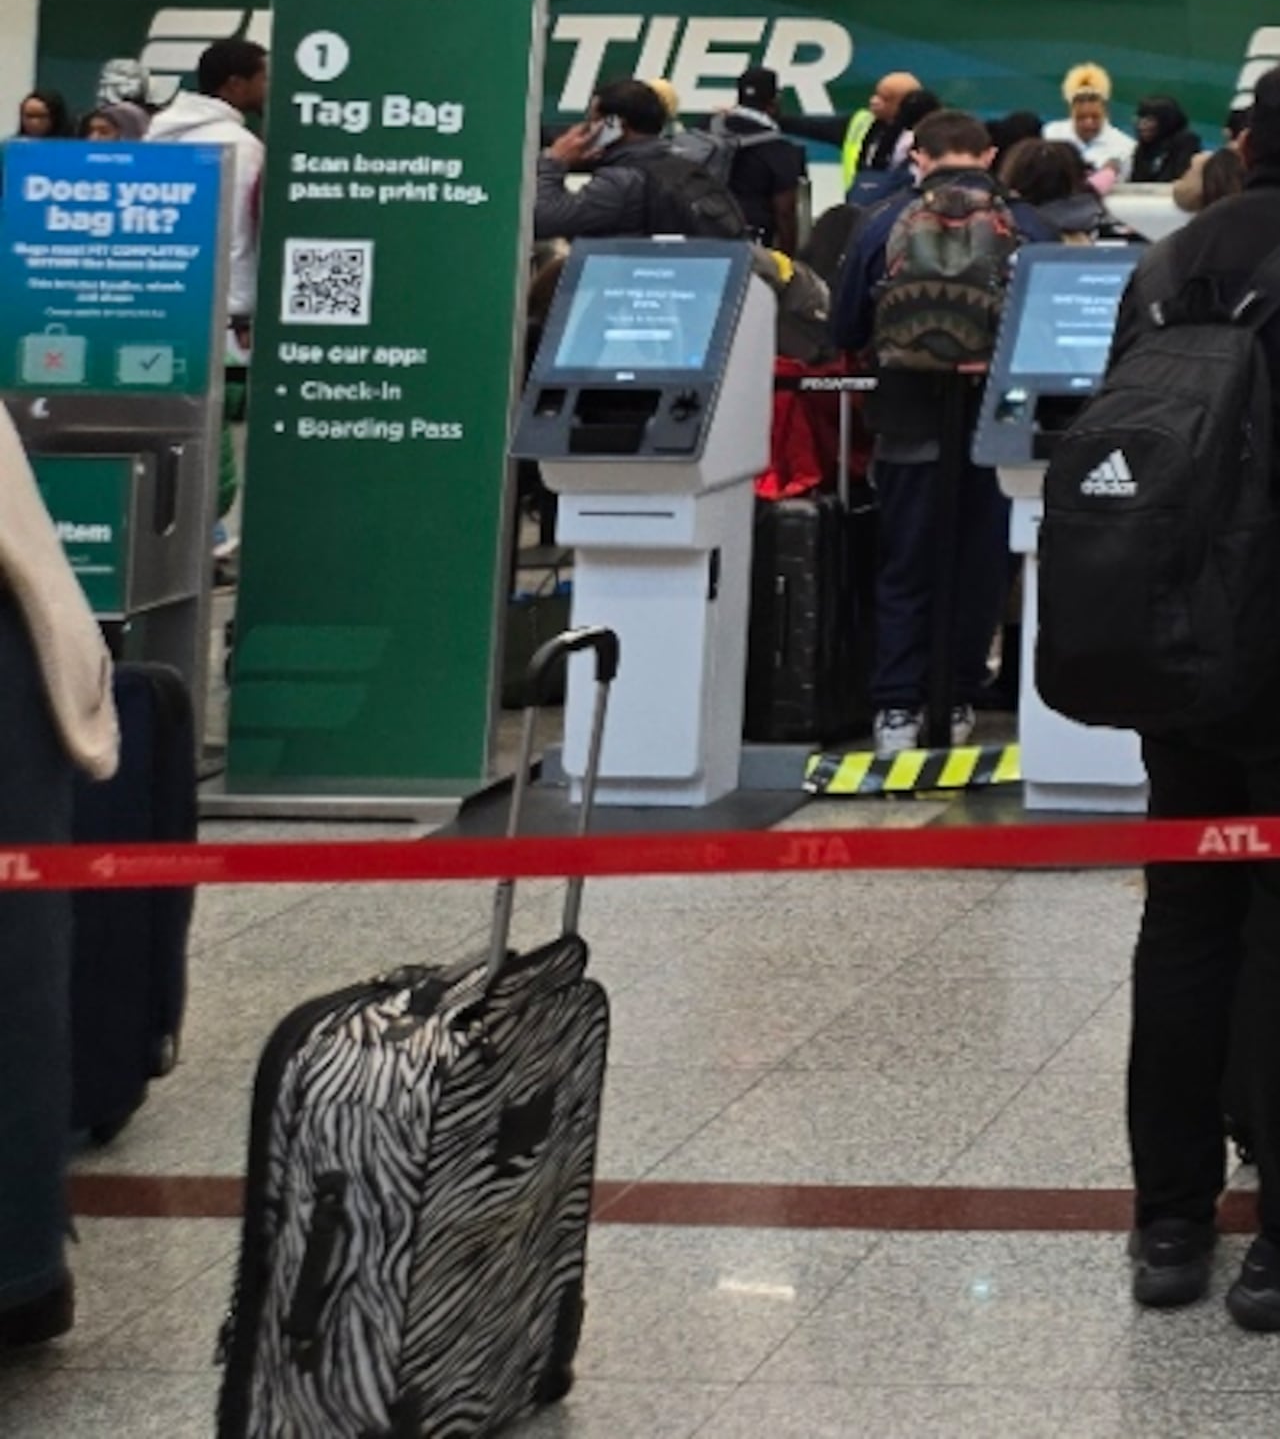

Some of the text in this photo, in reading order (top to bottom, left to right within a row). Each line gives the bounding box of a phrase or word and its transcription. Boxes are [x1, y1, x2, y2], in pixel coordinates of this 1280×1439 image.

[314, 43, 329, 69] 1
[292, 93, 464, 133] Tag Bag
[291, 153, 462, 178] Scan boarding
[23, 176, 197, 208] Does your
[289, 181, 489, 205] pass to print tag.
[46, 205, 180, 237] bag fit?
[278, 343, 427, 367] Use our app:
[297, 417, 463, 441] Boarding Pass
[1197, 824, 1271, 855] ATL
[0, 852, 41, 882] TL
